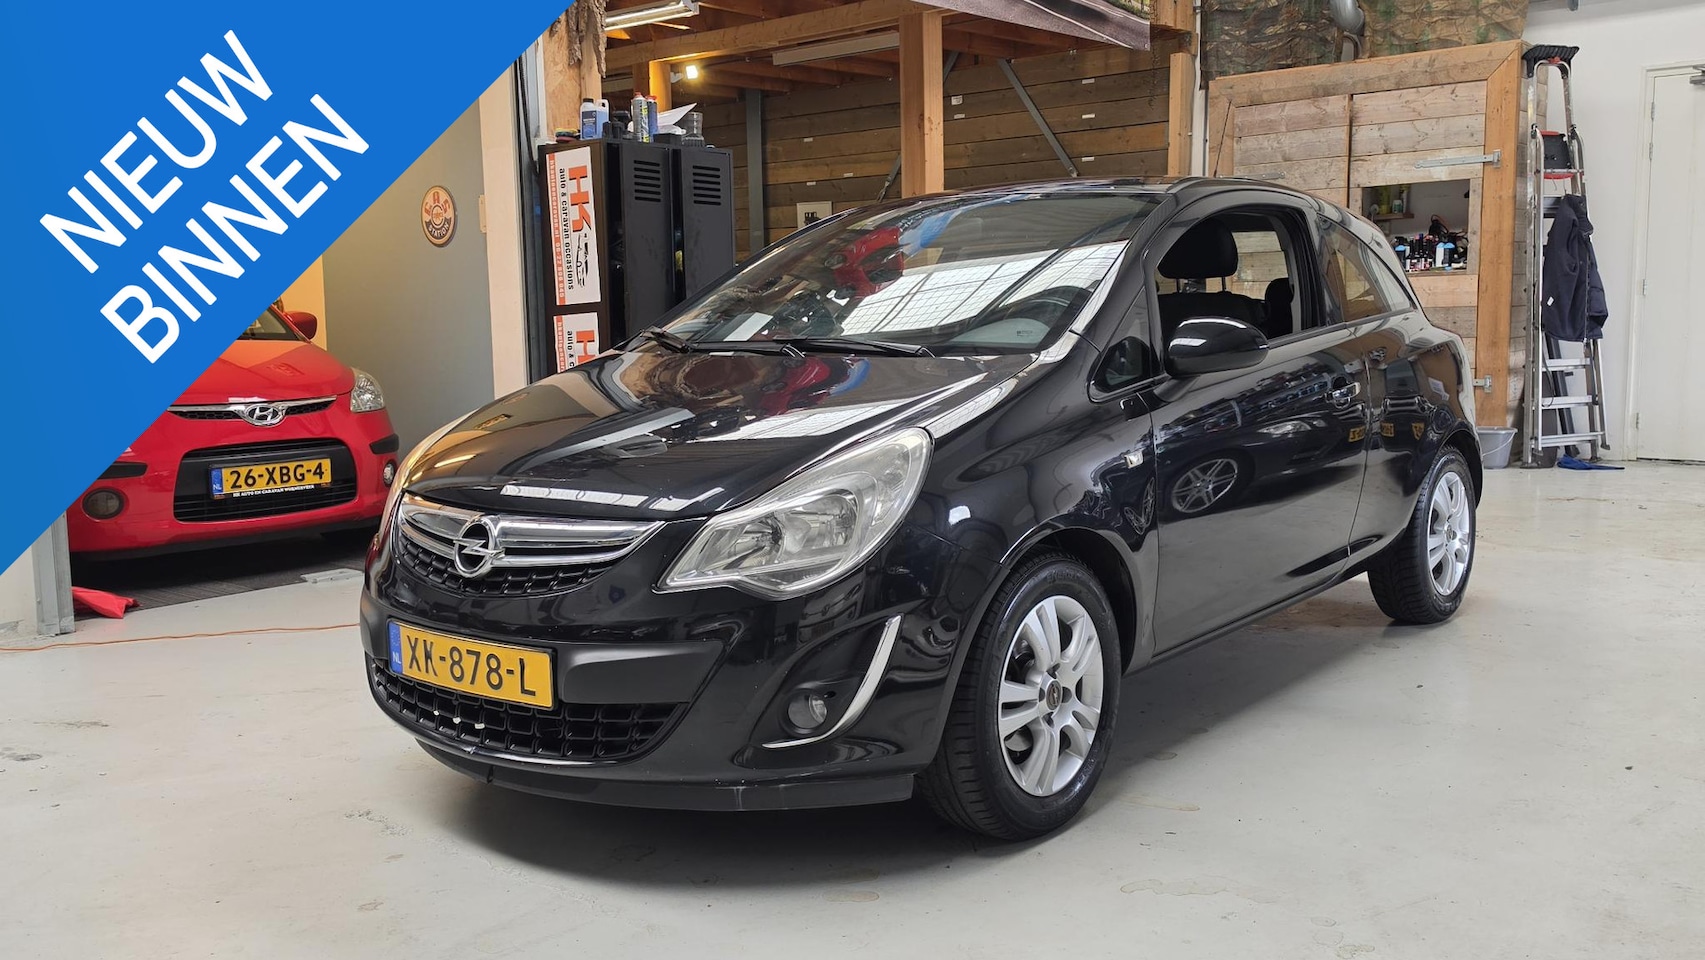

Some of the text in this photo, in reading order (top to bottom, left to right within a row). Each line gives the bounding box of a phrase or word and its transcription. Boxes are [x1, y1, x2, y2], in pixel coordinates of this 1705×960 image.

[559, 168, 567, 188] auto
[568, 165, 592, 232] HK
[428, 221, 449, 238] STATION
[561, 200, 569, 239] caravan
[564, 242, 574, 290] occasions
[229, 462, 325, 489] 26-XBG-4
[261, 487, 284, 495] CARAVAN
[392, 651, 402, 664] NL
[406, 635, 536, 697] XK-878-L
